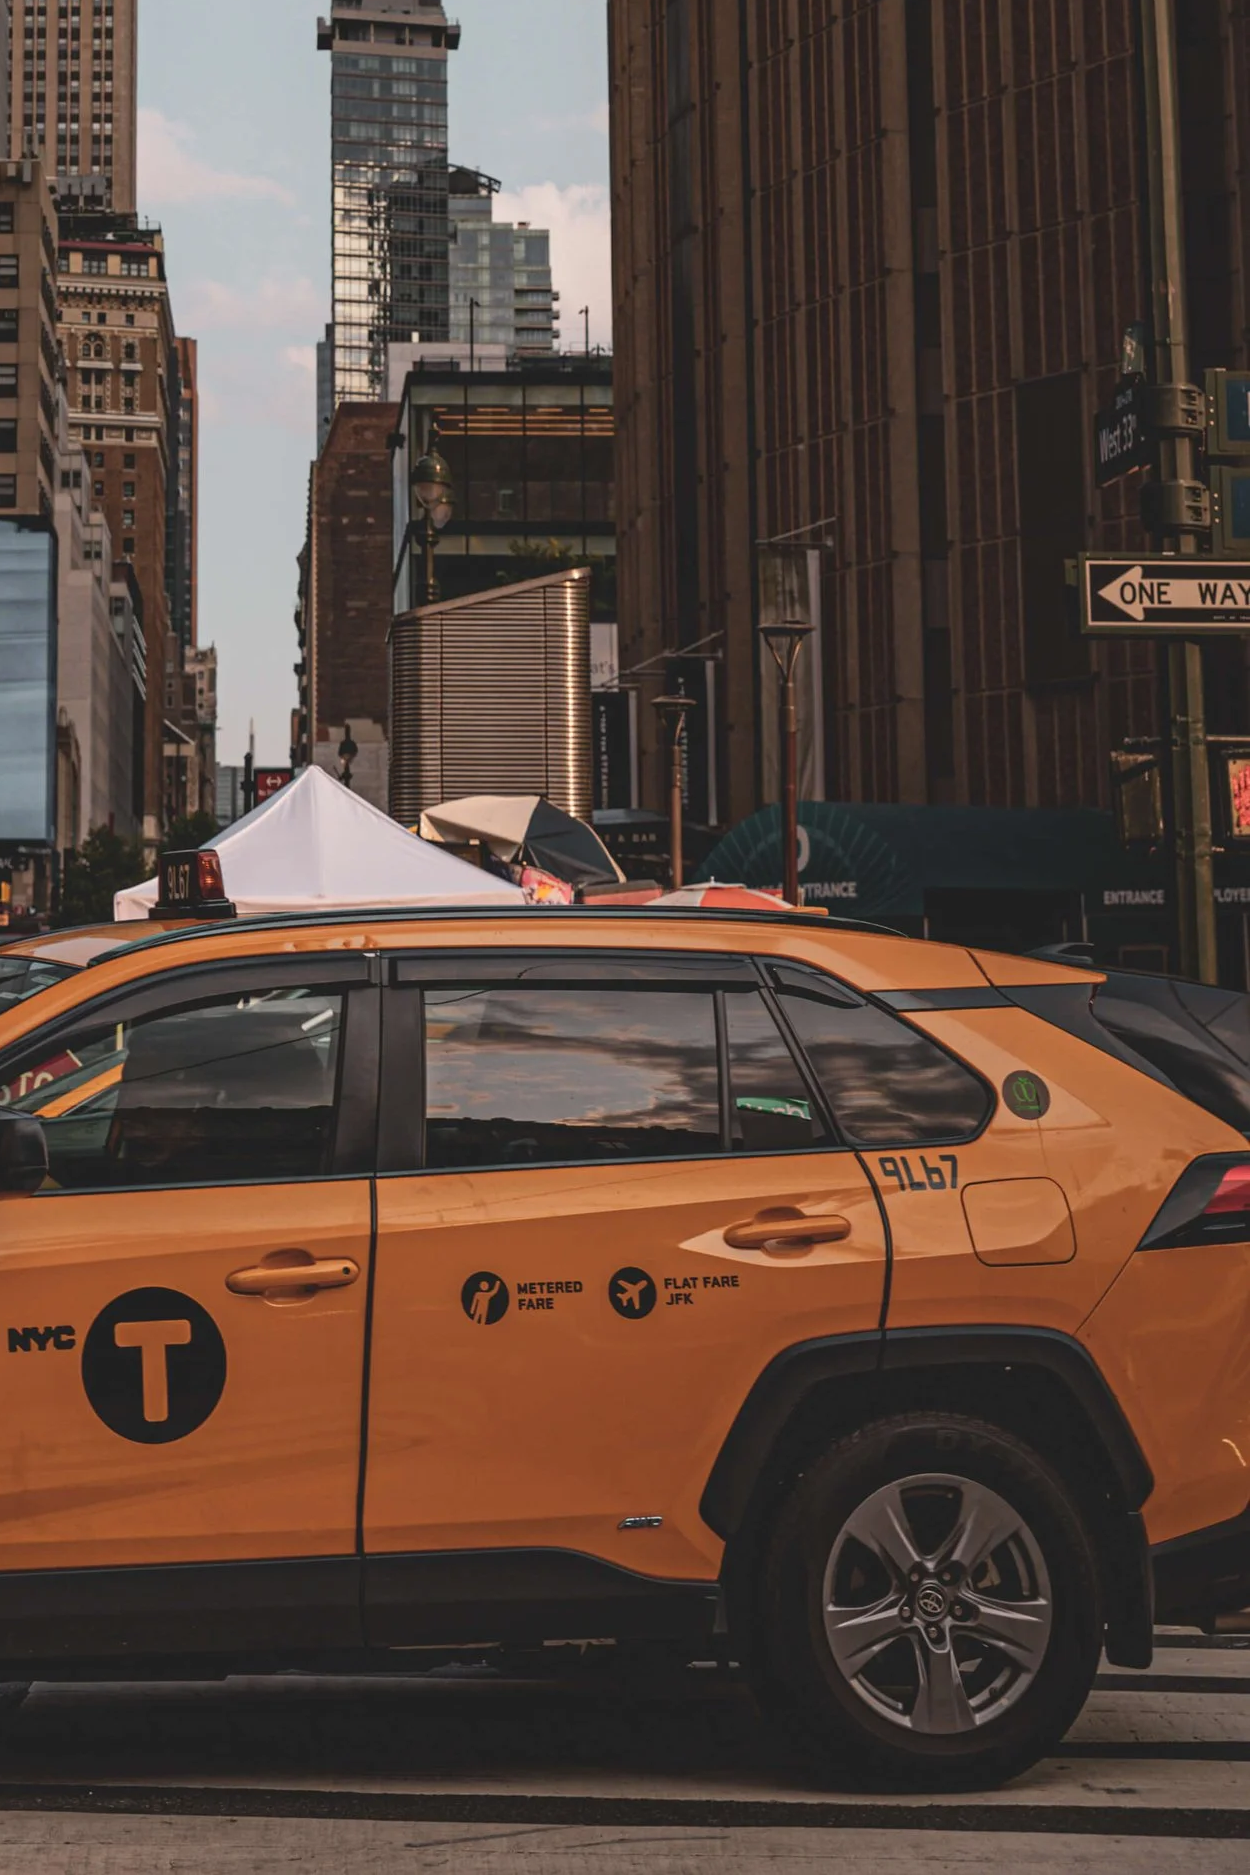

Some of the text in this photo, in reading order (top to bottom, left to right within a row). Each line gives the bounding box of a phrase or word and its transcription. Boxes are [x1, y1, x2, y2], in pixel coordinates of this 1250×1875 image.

[1099, 423, 1121, 463] West
[1120, 582, 1250, 605] ONE WAY
[167, 863, 190, 901] 9L67
[1103, 889, 1166, 906] ENTRANCE
[878, 1154, 958, 1192] 9L67
[517, 1280, 584, 1295] METERED
[664, 1274, 740, 1290] FLAT FARE
[518, 1297, 555, 1311] FARE
[665, 1292, 694, 1306] JFK
[7, 1325, 76, 1352] NYC
[114, 1318, 192, 1423] T
